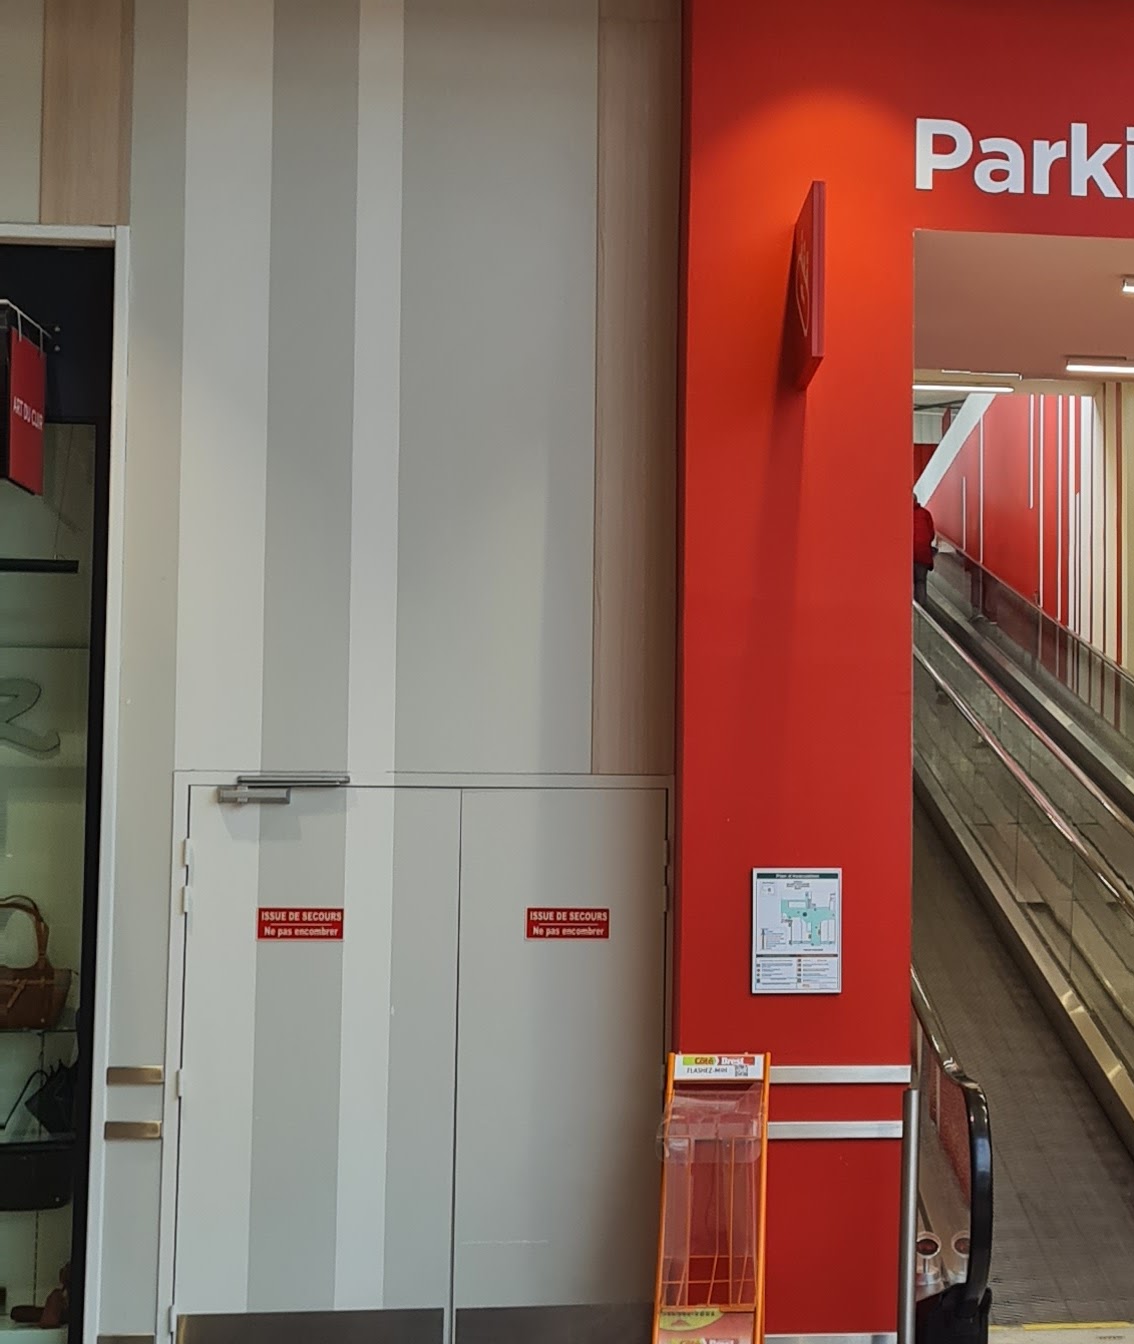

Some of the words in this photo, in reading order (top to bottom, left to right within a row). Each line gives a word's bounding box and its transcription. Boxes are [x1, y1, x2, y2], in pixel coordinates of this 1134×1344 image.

[12, 395, 24, 417] ART
[23, 402, 32, 424] DU
[261, 910, 287, 921] ISSUE
[288, 911, 300, 921] DE
[301, 911, 342, 922] SECOURS
[529, 910, 555, 921] ISSUE
[556, 911, 568, 921] DE
[569, 911, 608, 922] SECOURS
[264, 926, 276, 936] Ne
[277, 928, 292, 938] pas
[294, 926, 338, 936] encombrer
[532, 925, 544, 935] Ne
[545, 928, 560, 938] pas
[562, 926, 605, 936] encombrer
[721, 1056, 744, 1066] Brest
